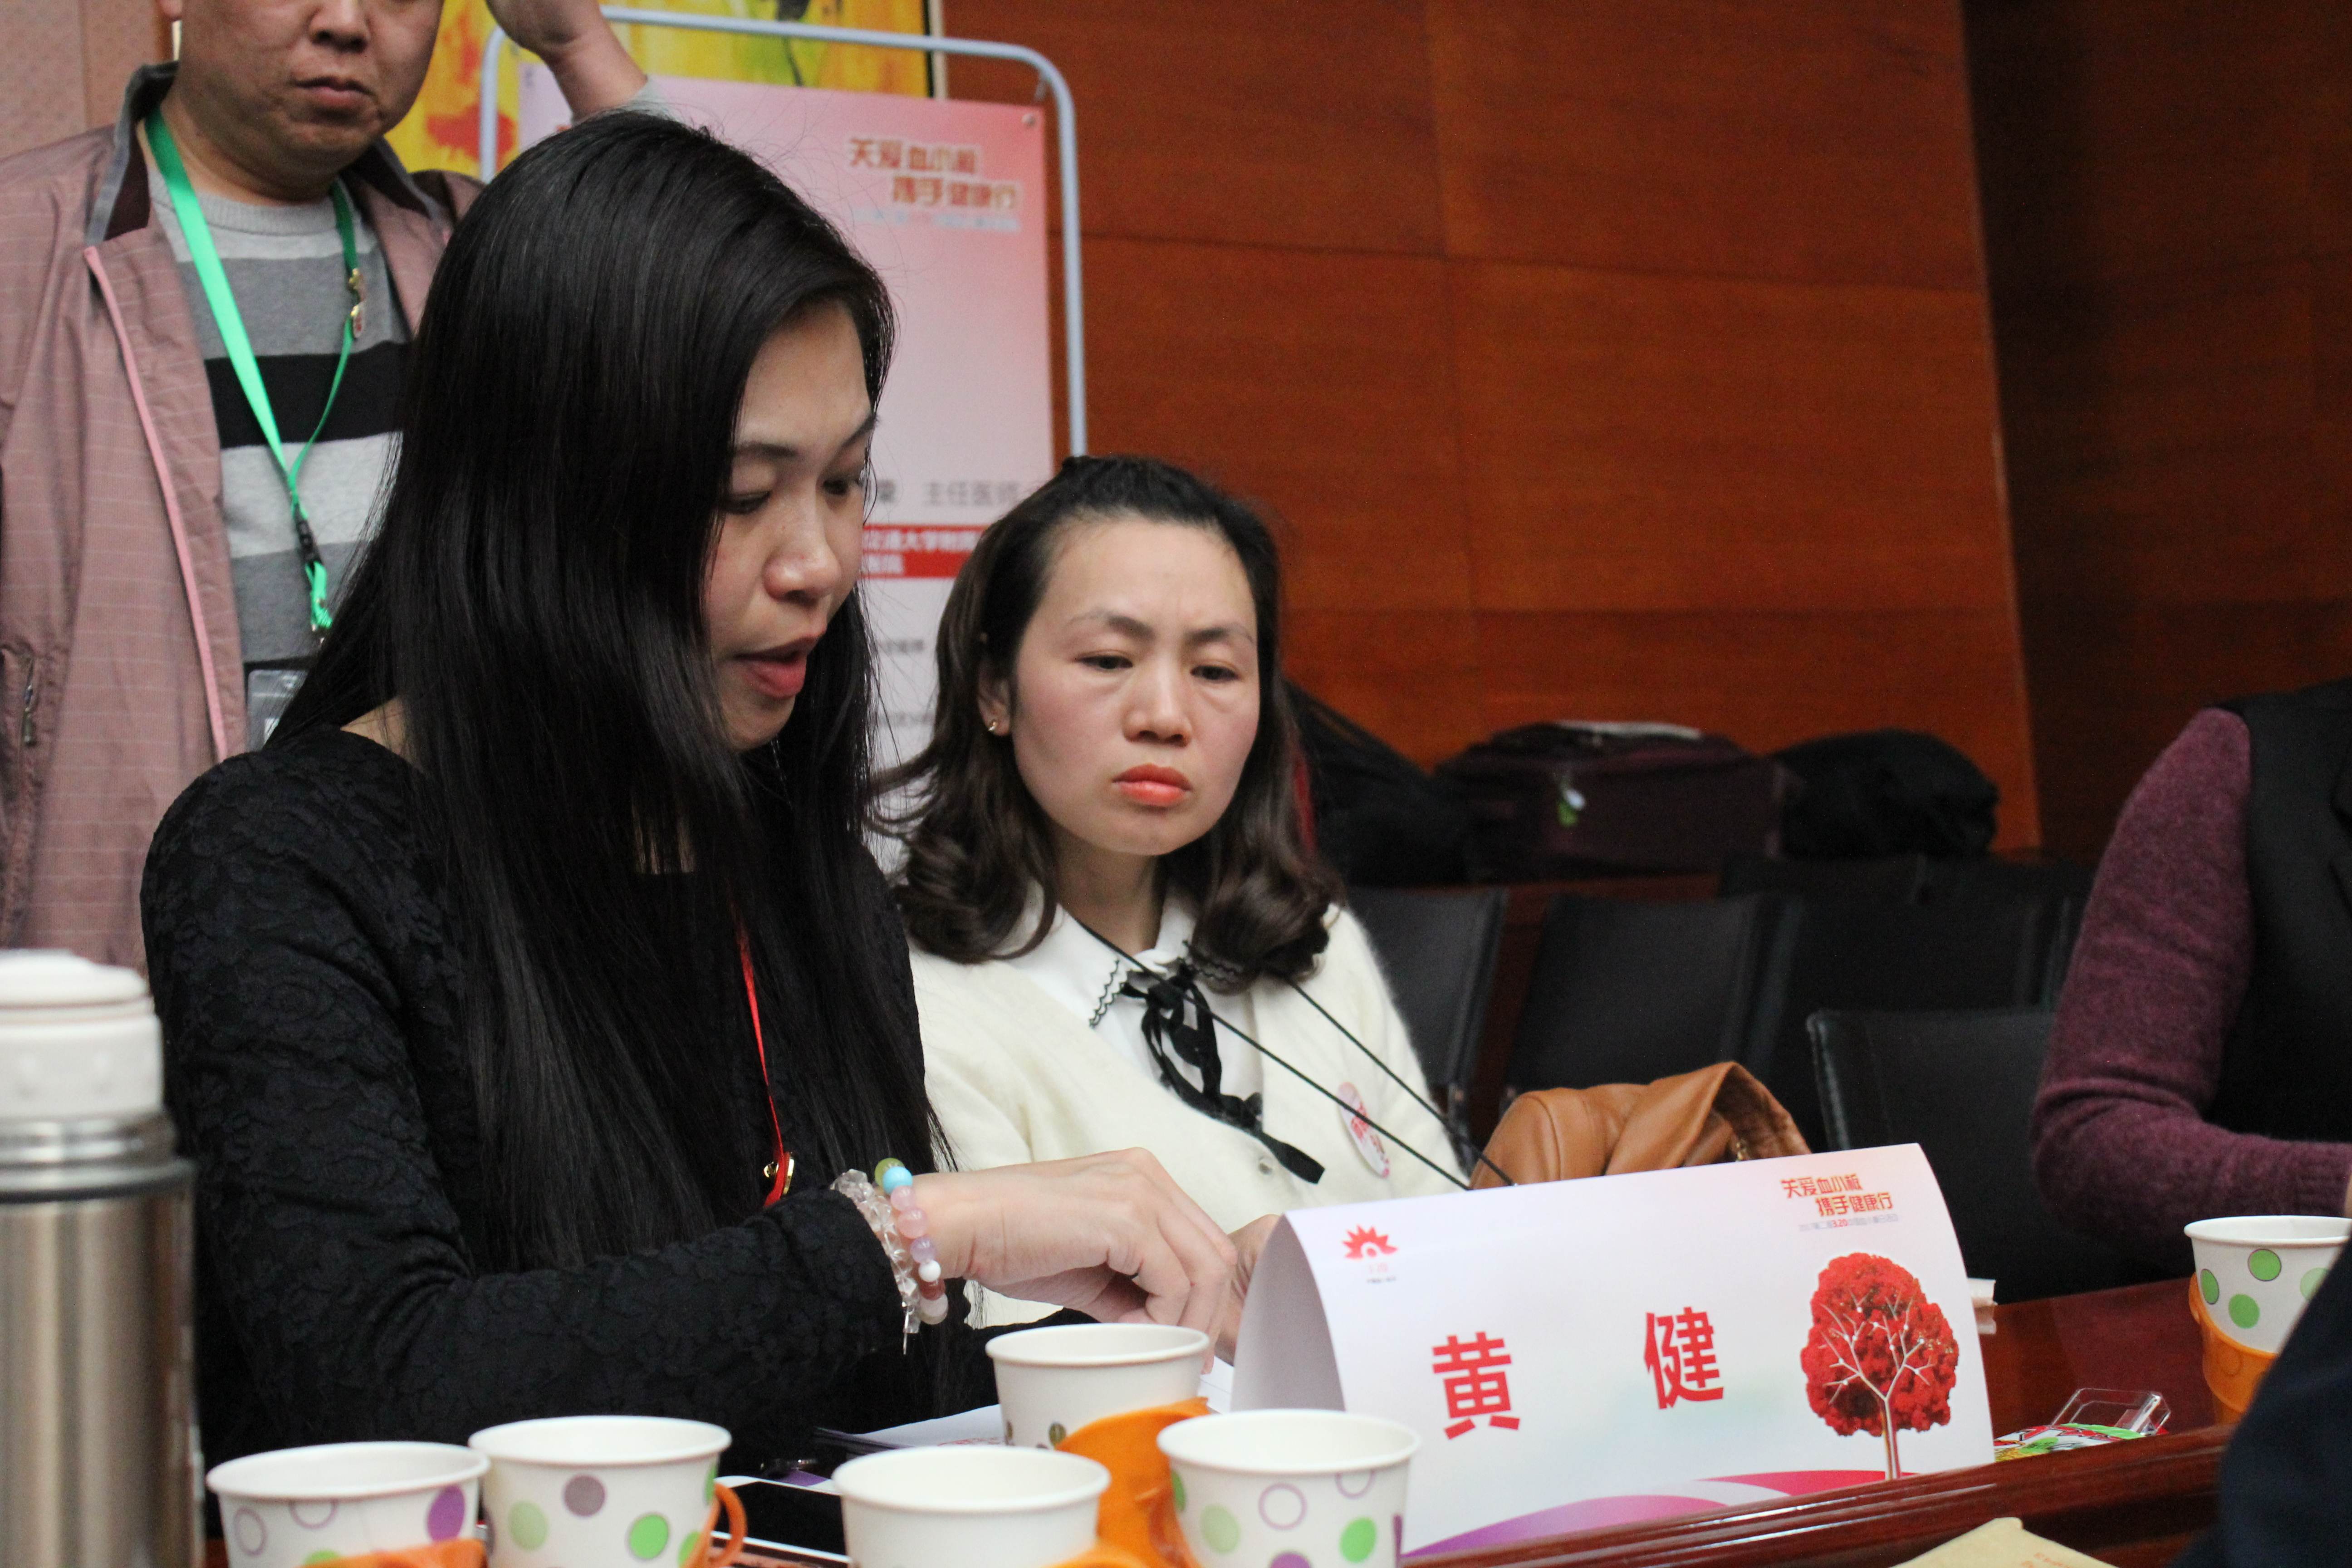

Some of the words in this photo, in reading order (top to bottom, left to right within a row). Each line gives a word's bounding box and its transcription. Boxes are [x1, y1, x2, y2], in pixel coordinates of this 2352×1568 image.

[1781, 1173, 1862, 1198] 关爱血小板
[1815, 1192, 1893, 1216] 携手健康行
[1431, 1332, 1520, 1440] 黄
[1644, 1307, 1724, 1409] 健
